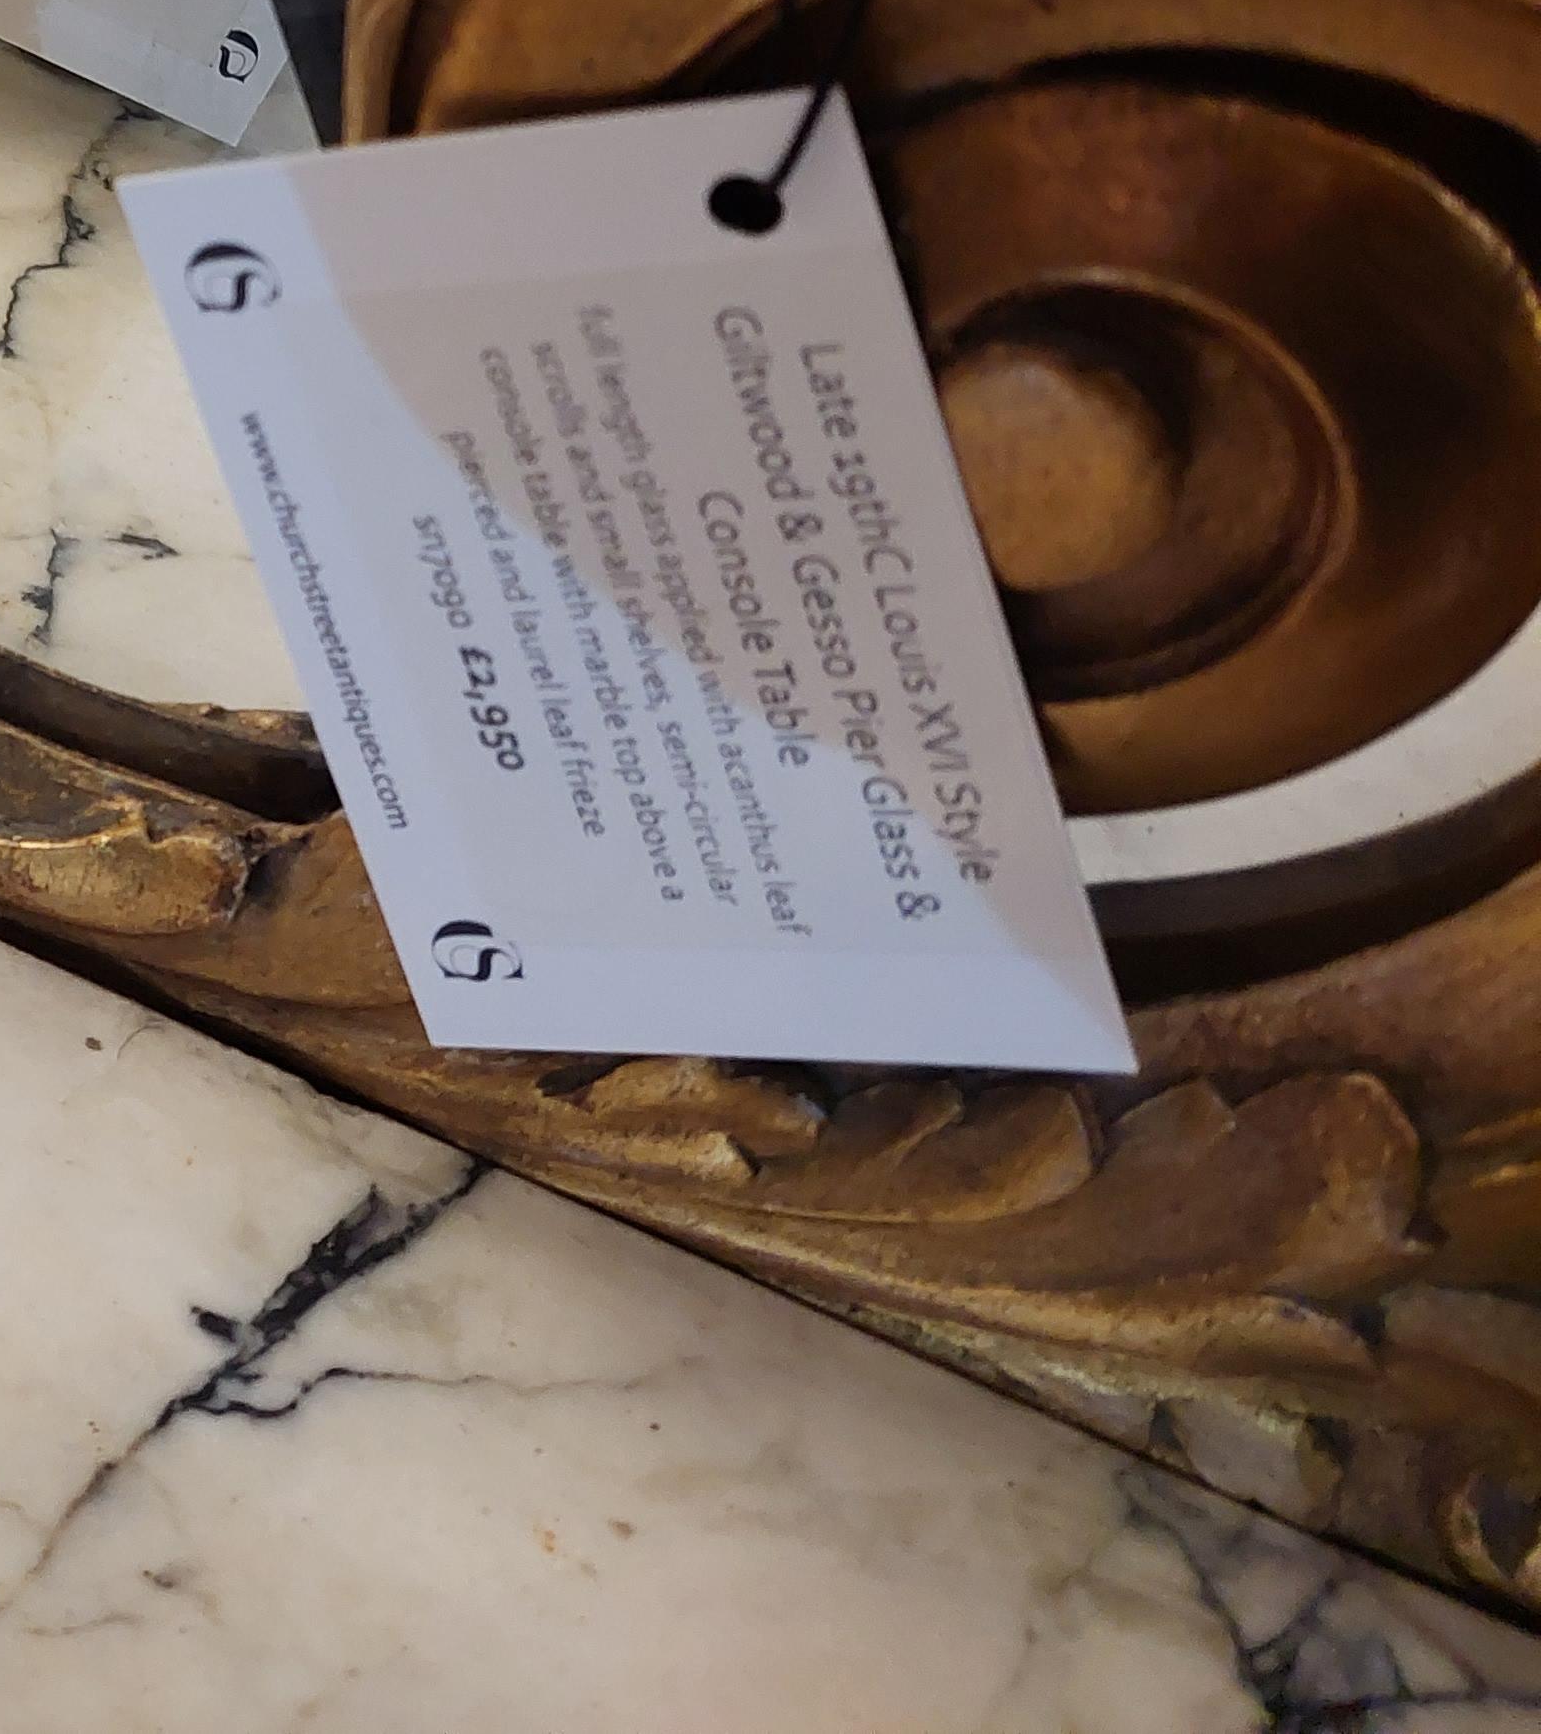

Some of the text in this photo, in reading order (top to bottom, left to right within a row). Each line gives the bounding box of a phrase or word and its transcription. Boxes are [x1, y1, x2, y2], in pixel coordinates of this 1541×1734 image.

[596, 360, 654, 464] length
[617, 468, 676, 548] glass
[240, 411, 409, 830] www.churchstreetantiques.com
[411, 514, 525, 771] sn7090 £2,950
[438, 430, 606, 837] pierced and laurel leaf frieze
[477, 346, 685, 901] console table with marble top above a
[529, 338, 739, 907] scrolls and small shelves, semi-circular
[650, 552, 725, 665] applied
[695, 668, 744, 737] with
[696, 489, 817, 767] Console Table
[711, 305, 942, 920] Giltwood & Gesso Pier Glass &
[797, 342, 999, 883] Late 19thC Louis XVI Style
[716, 741, 781, 874] acanthus
[762, 880, 813, 937] leaf
